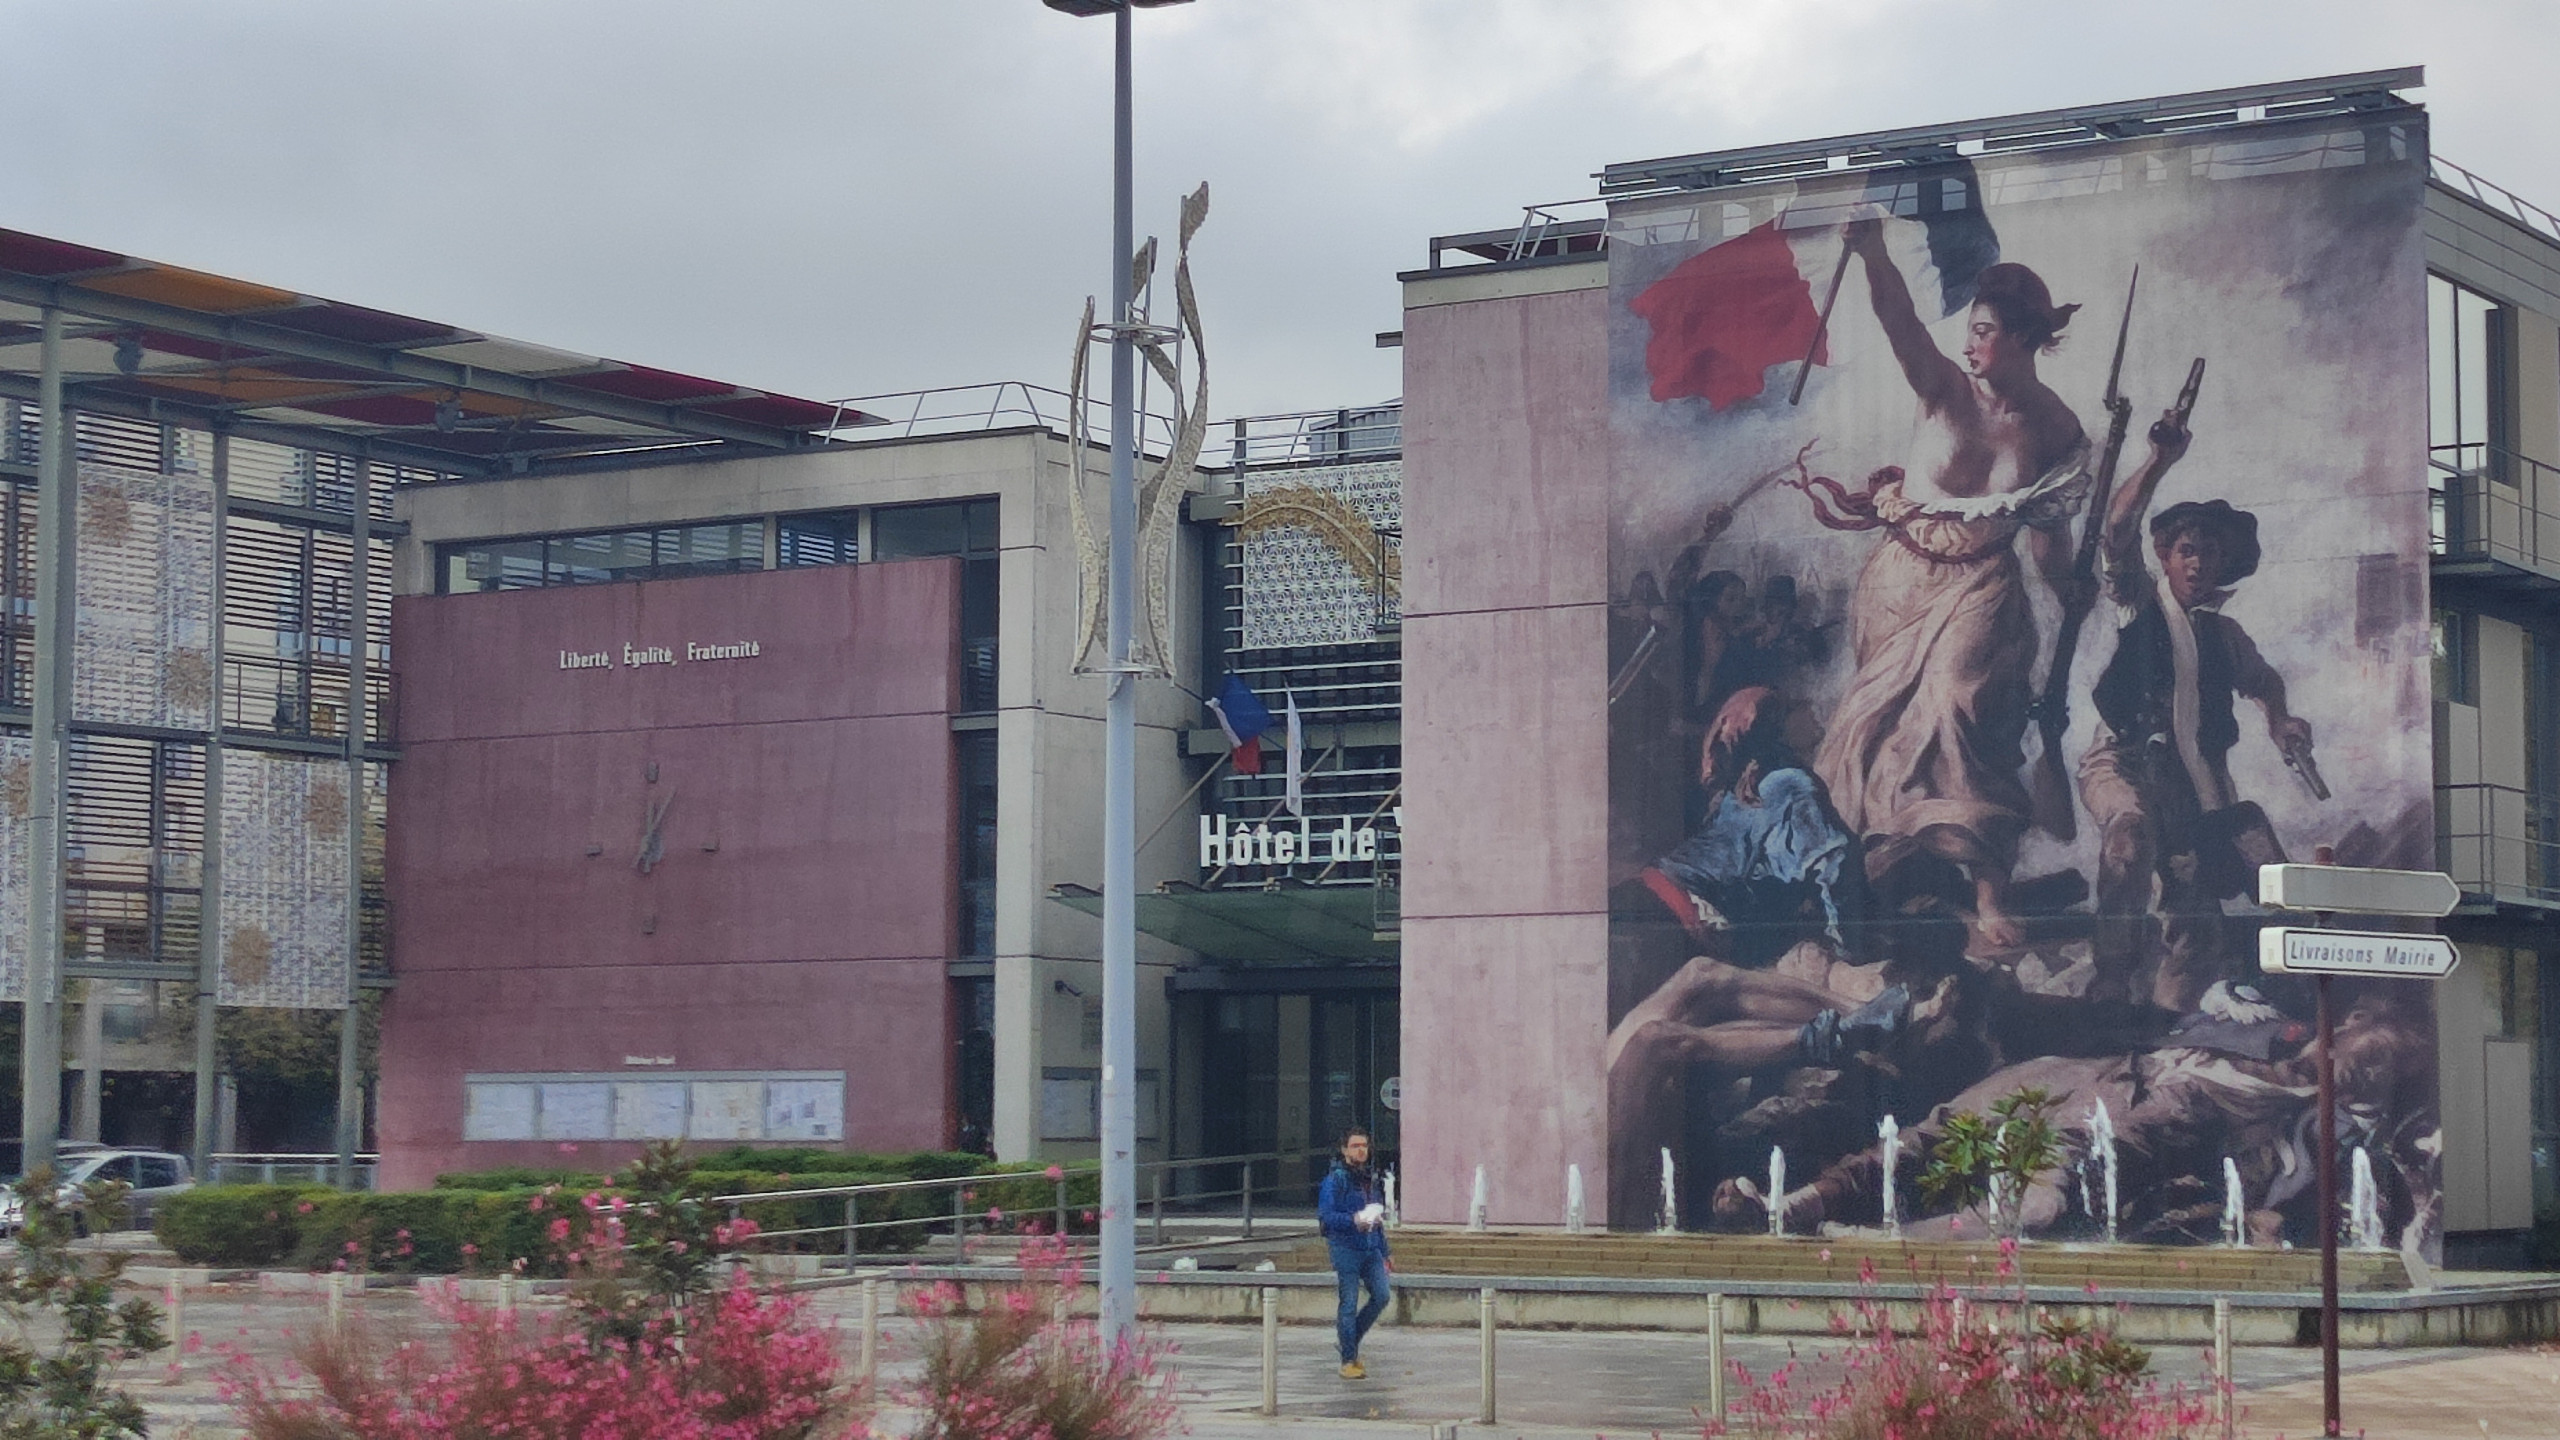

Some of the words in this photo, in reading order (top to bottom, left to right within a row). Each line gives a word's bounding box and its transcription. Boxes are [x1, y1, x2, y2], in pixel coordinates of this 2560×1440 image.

[560, 650, 614, 670] Liberté,
[623, 641, 678, 668] Égalité,
[687, 640, 760, 661] Fraternité
[1200, 814, 1310, 867] Hôtel
[1331, 814, 1376, 862] de
[2290, 941, 2373, 964] Livraisons
[2384, 946, 2435, 967] Mairie
